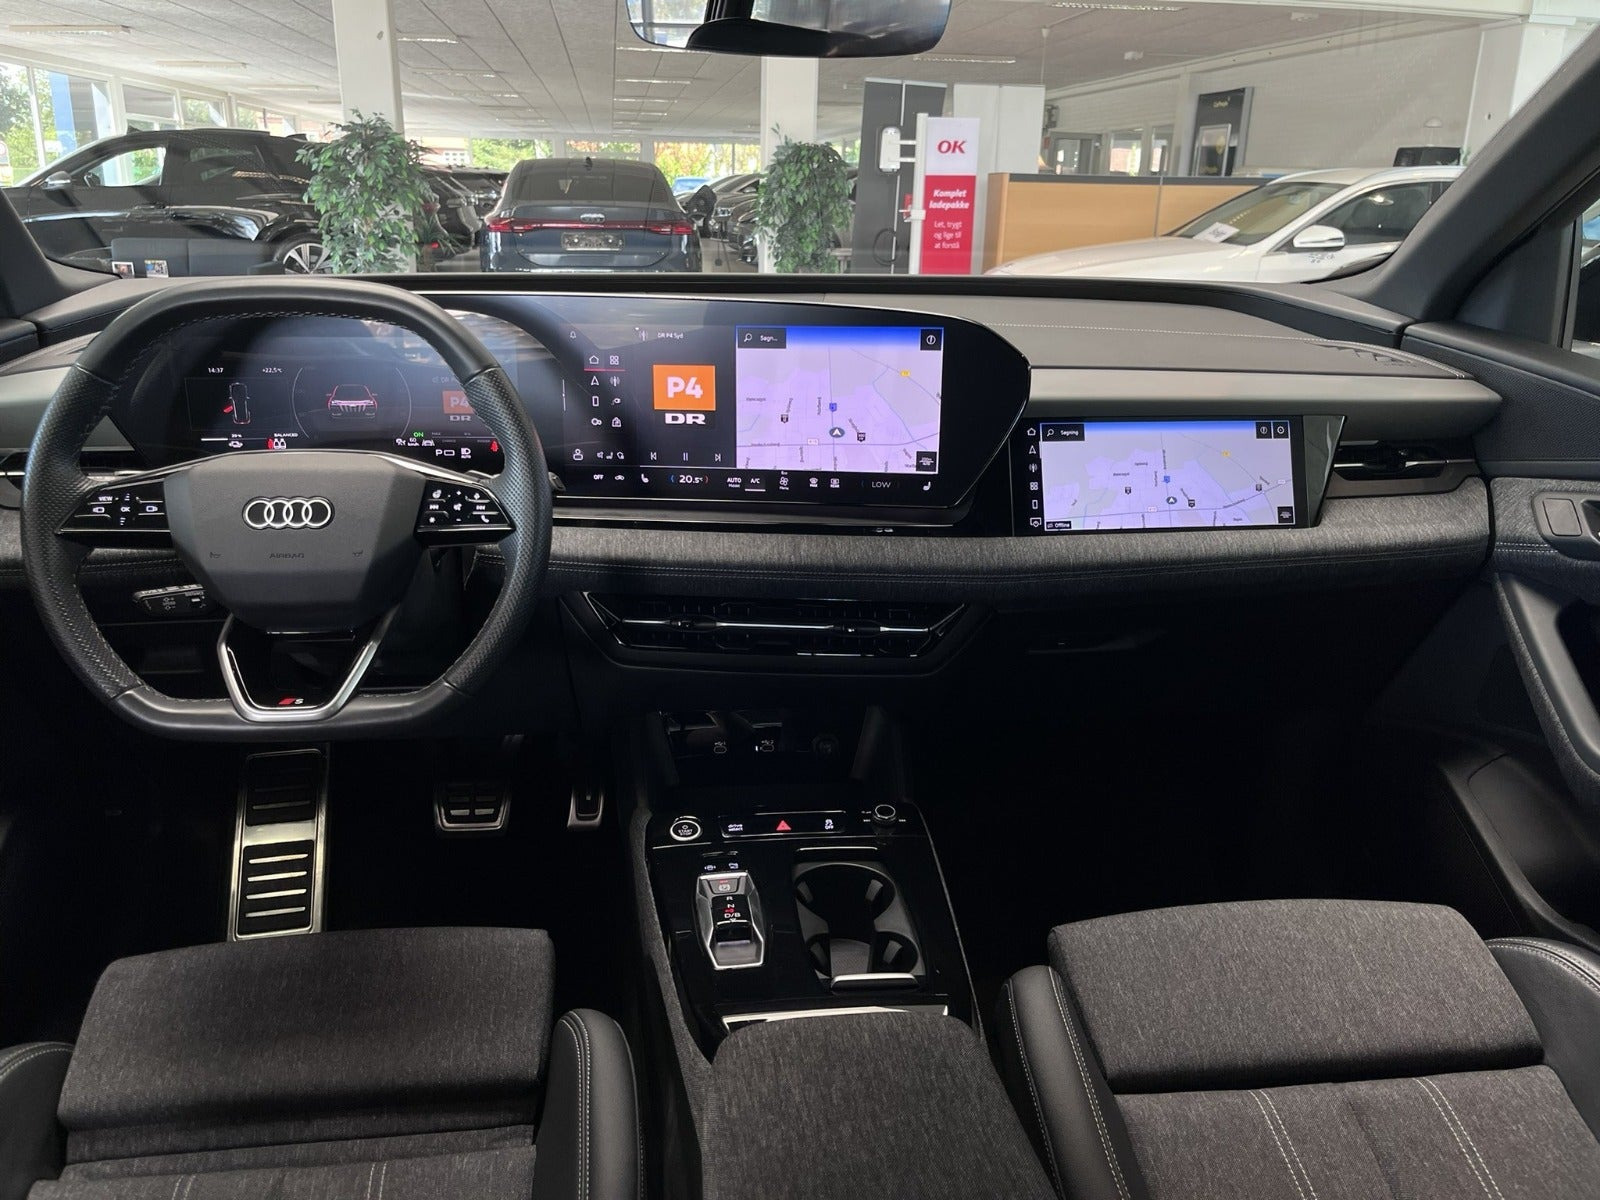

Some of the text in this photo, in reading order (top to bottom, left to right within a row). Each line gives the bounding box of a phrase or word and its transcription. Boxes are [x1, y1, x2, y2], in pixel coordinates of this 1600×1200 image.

[937, 140, 966, 154] OK
[933, 189, 967, 199] Komplet
[929, 200, 969, 211] ladepakke
[934, 220, 962, 230] Let, trygt
[934, 233, 942, 241] og
[943, 231, 954, 240] lige
[934, 240, 960, 249] at forstå
[667, 376, 703, 399] P4
[450, 396, 469, 408] P4
[665, 413, 706, 425] DR
[871, 481, 891, 489] LOW
